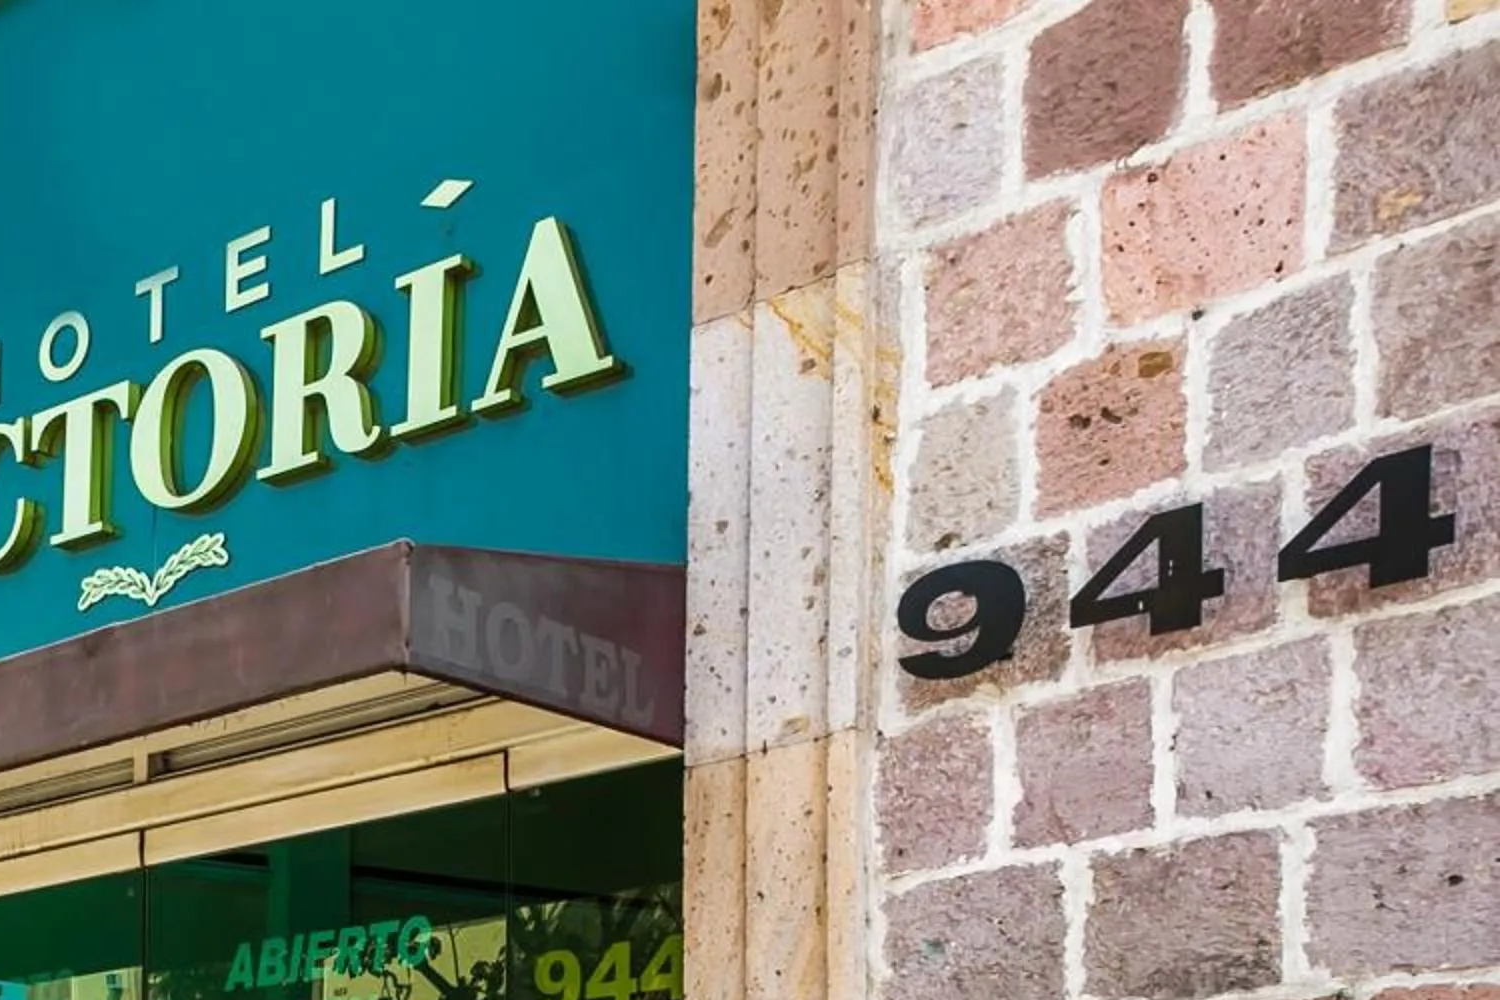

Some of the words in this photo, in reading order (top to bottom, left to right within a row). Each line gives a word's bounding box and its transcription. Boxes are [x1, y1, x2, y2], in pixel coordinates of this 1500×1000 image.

[896, 443, 1456, 680] 944
[428, 572, 655, 727] HOTEL
[223, 914, 433, 993] ABIERTO
